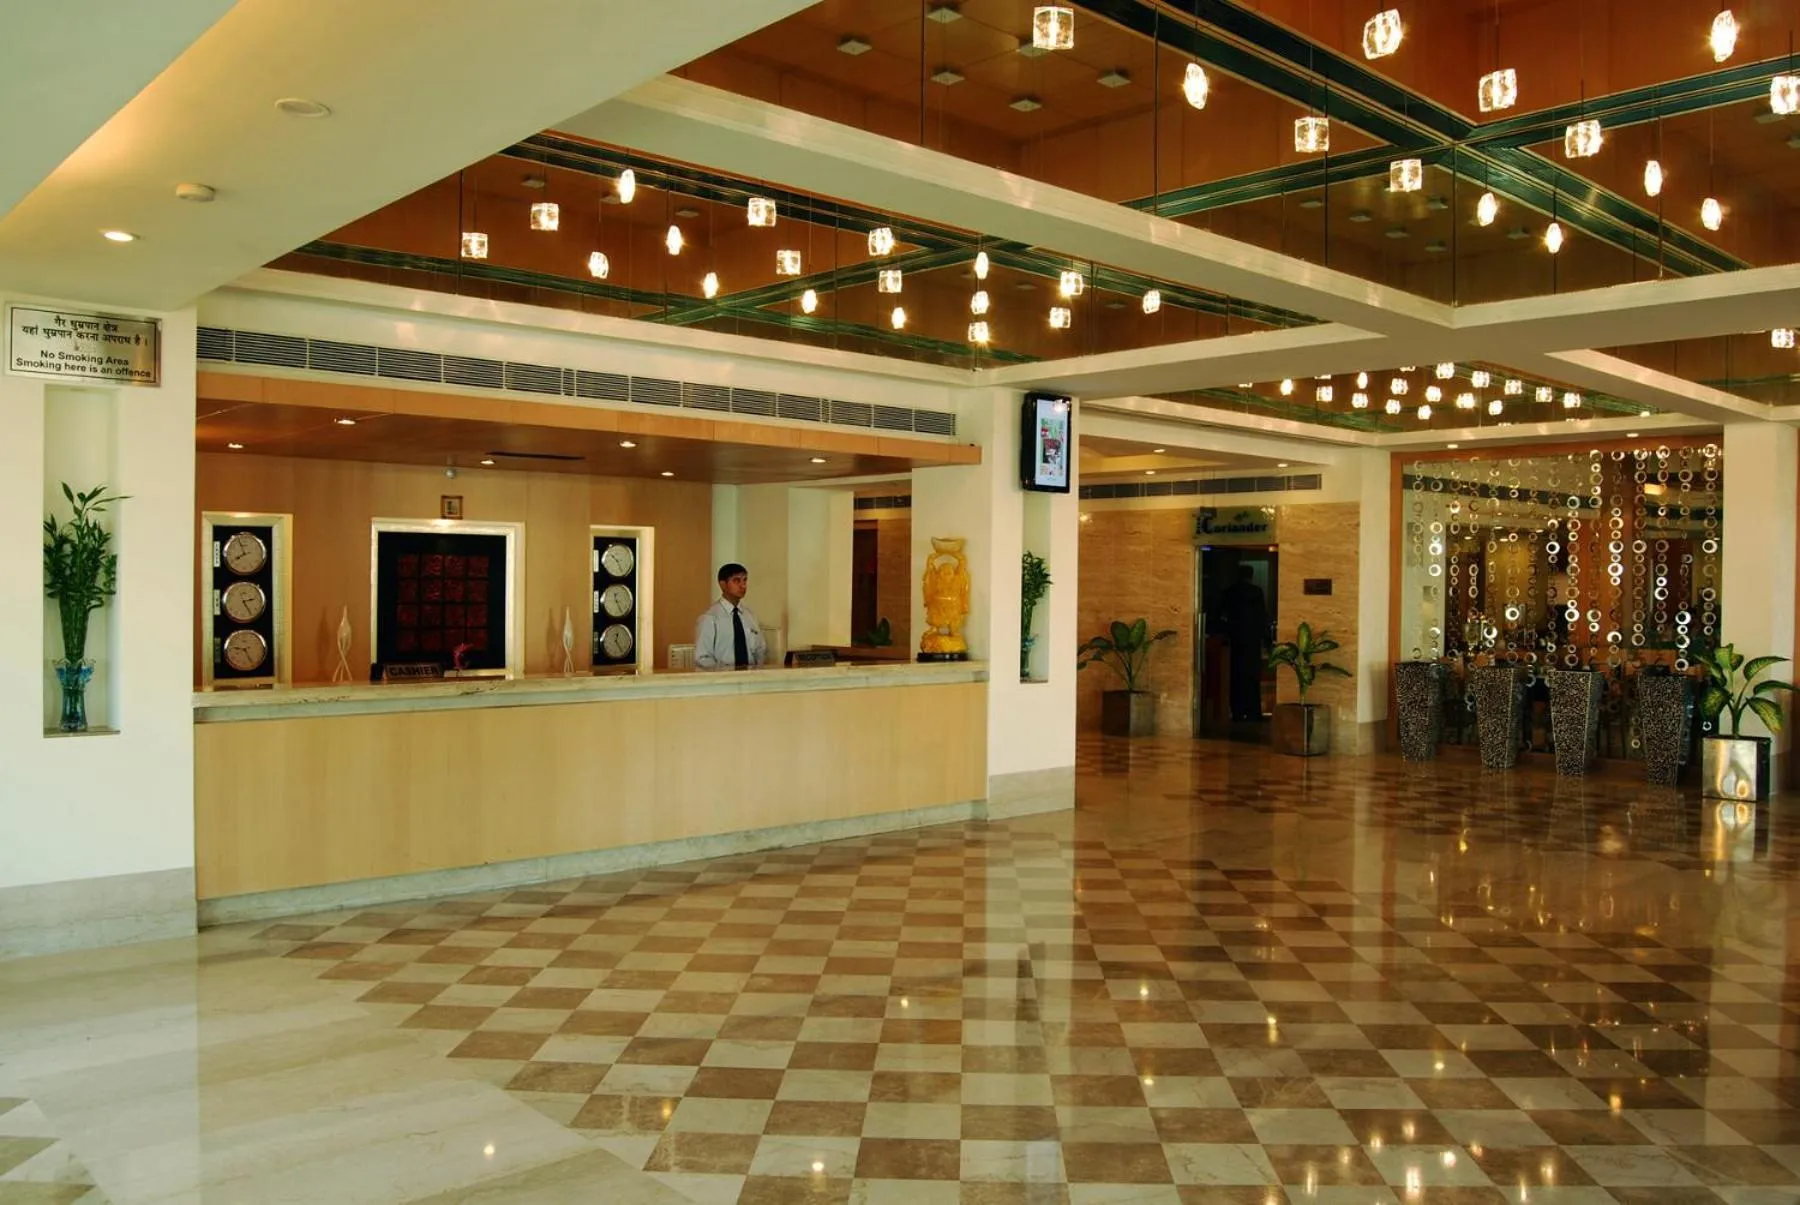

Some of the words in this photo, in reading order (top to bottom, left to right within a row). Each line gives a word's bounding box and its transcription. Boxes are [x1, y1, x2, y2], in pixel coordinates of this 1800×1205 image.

[54, 315, 66, 327] गैर
[76, 331, 99, 342] करना
[40, 349, 55, 359] No
[58, 351, 103, 366] Smoking
[106, 356, 129, 366] Area
[15, 356, 62, 372] Smoking
[64, 362, 87, 372] here
[90, 365, 98, 373] is
[101, 366, 113, 374] an
[115, 367, 151, 378] offence
[389, 665, 440, 677] CASHIER
